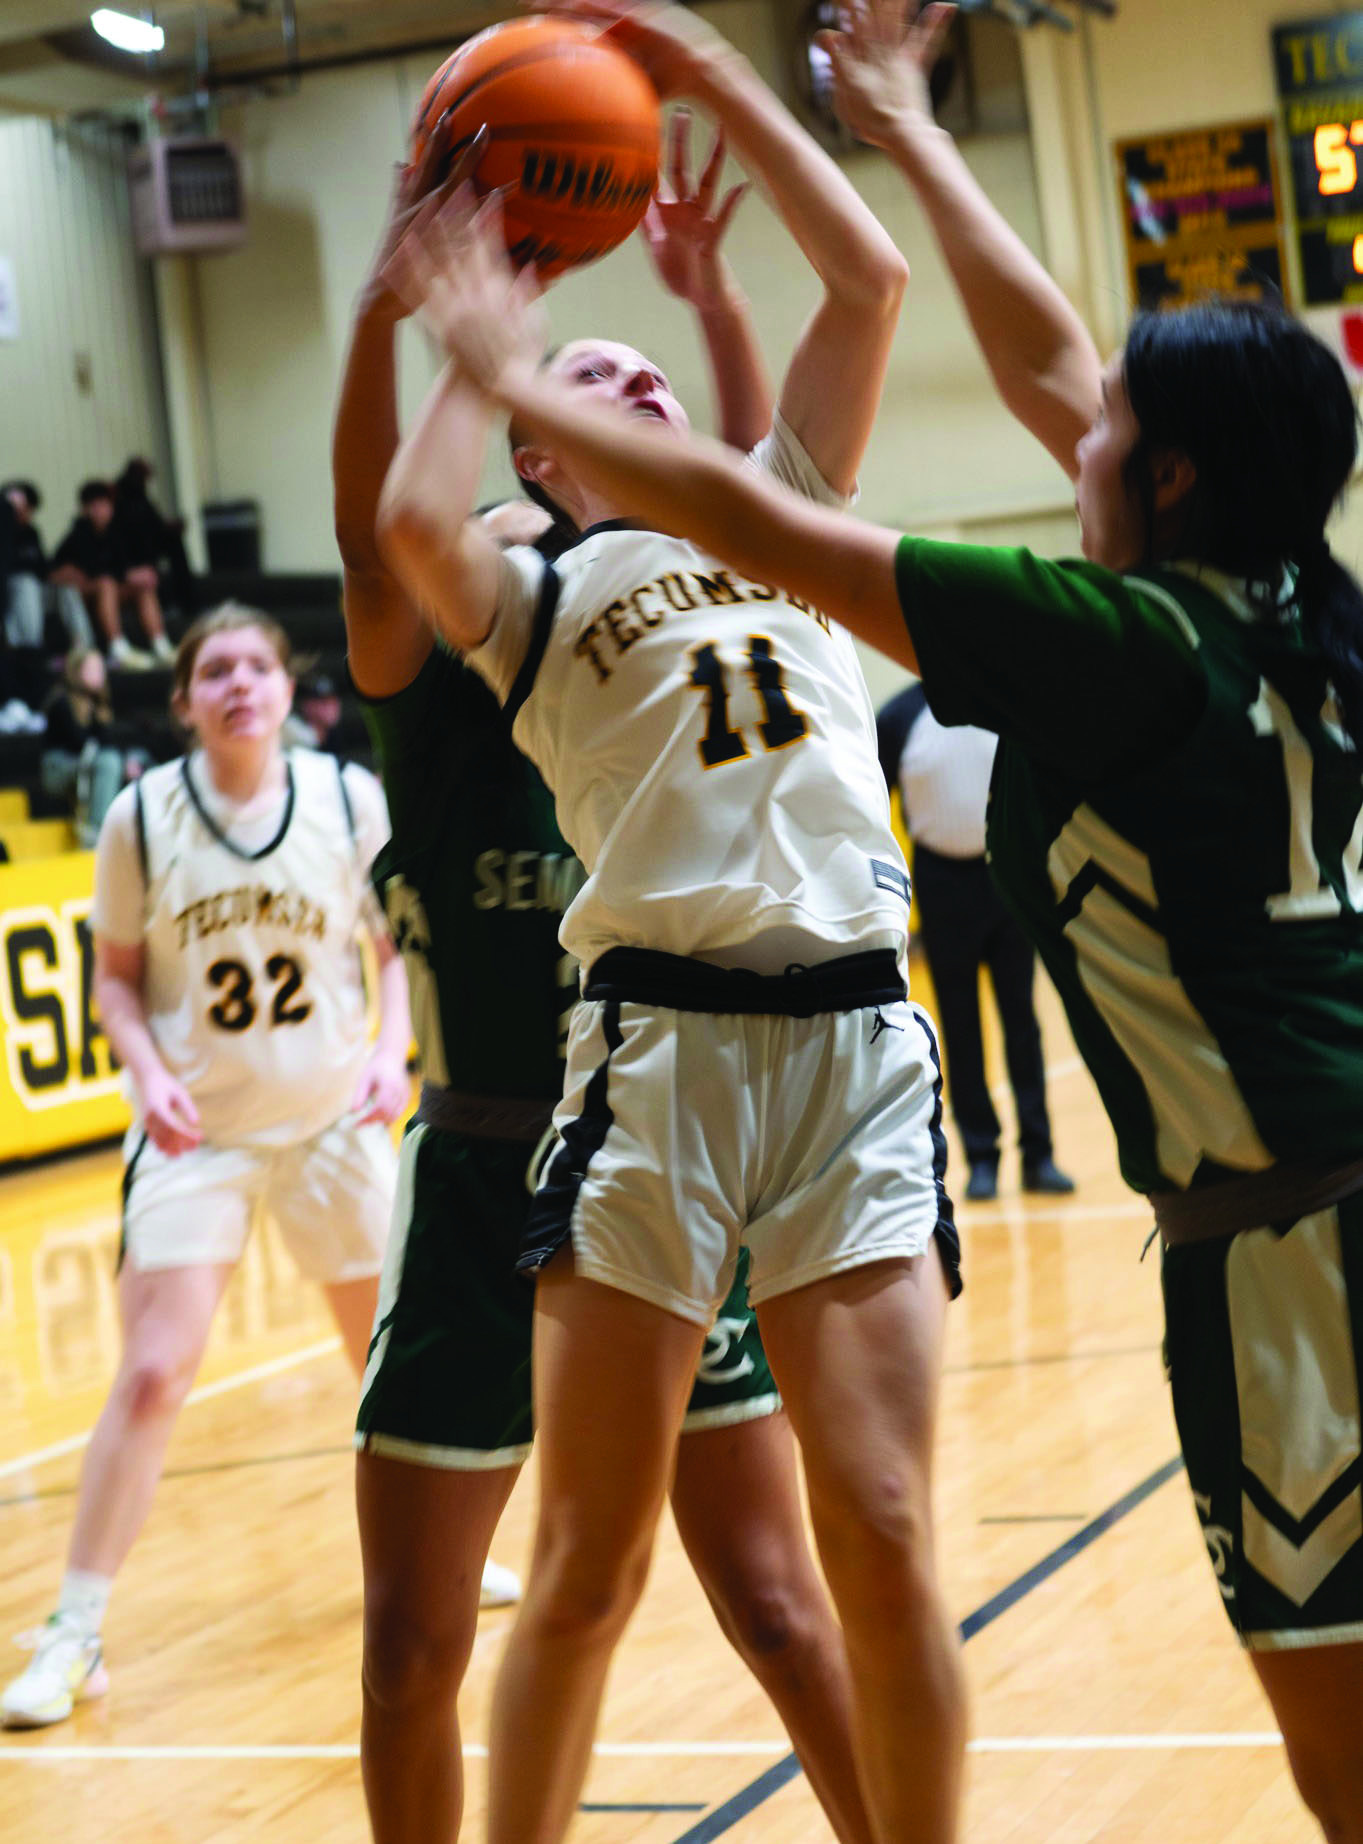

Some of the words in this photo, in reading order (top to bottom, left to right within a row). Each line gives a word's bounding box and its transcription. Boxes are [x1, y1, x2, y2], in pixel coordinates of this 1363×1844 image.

[573, 569, 833, 686] TECUMS
[687, 632, 812, 771] 11
[207, 952, 313, 1033] 32
